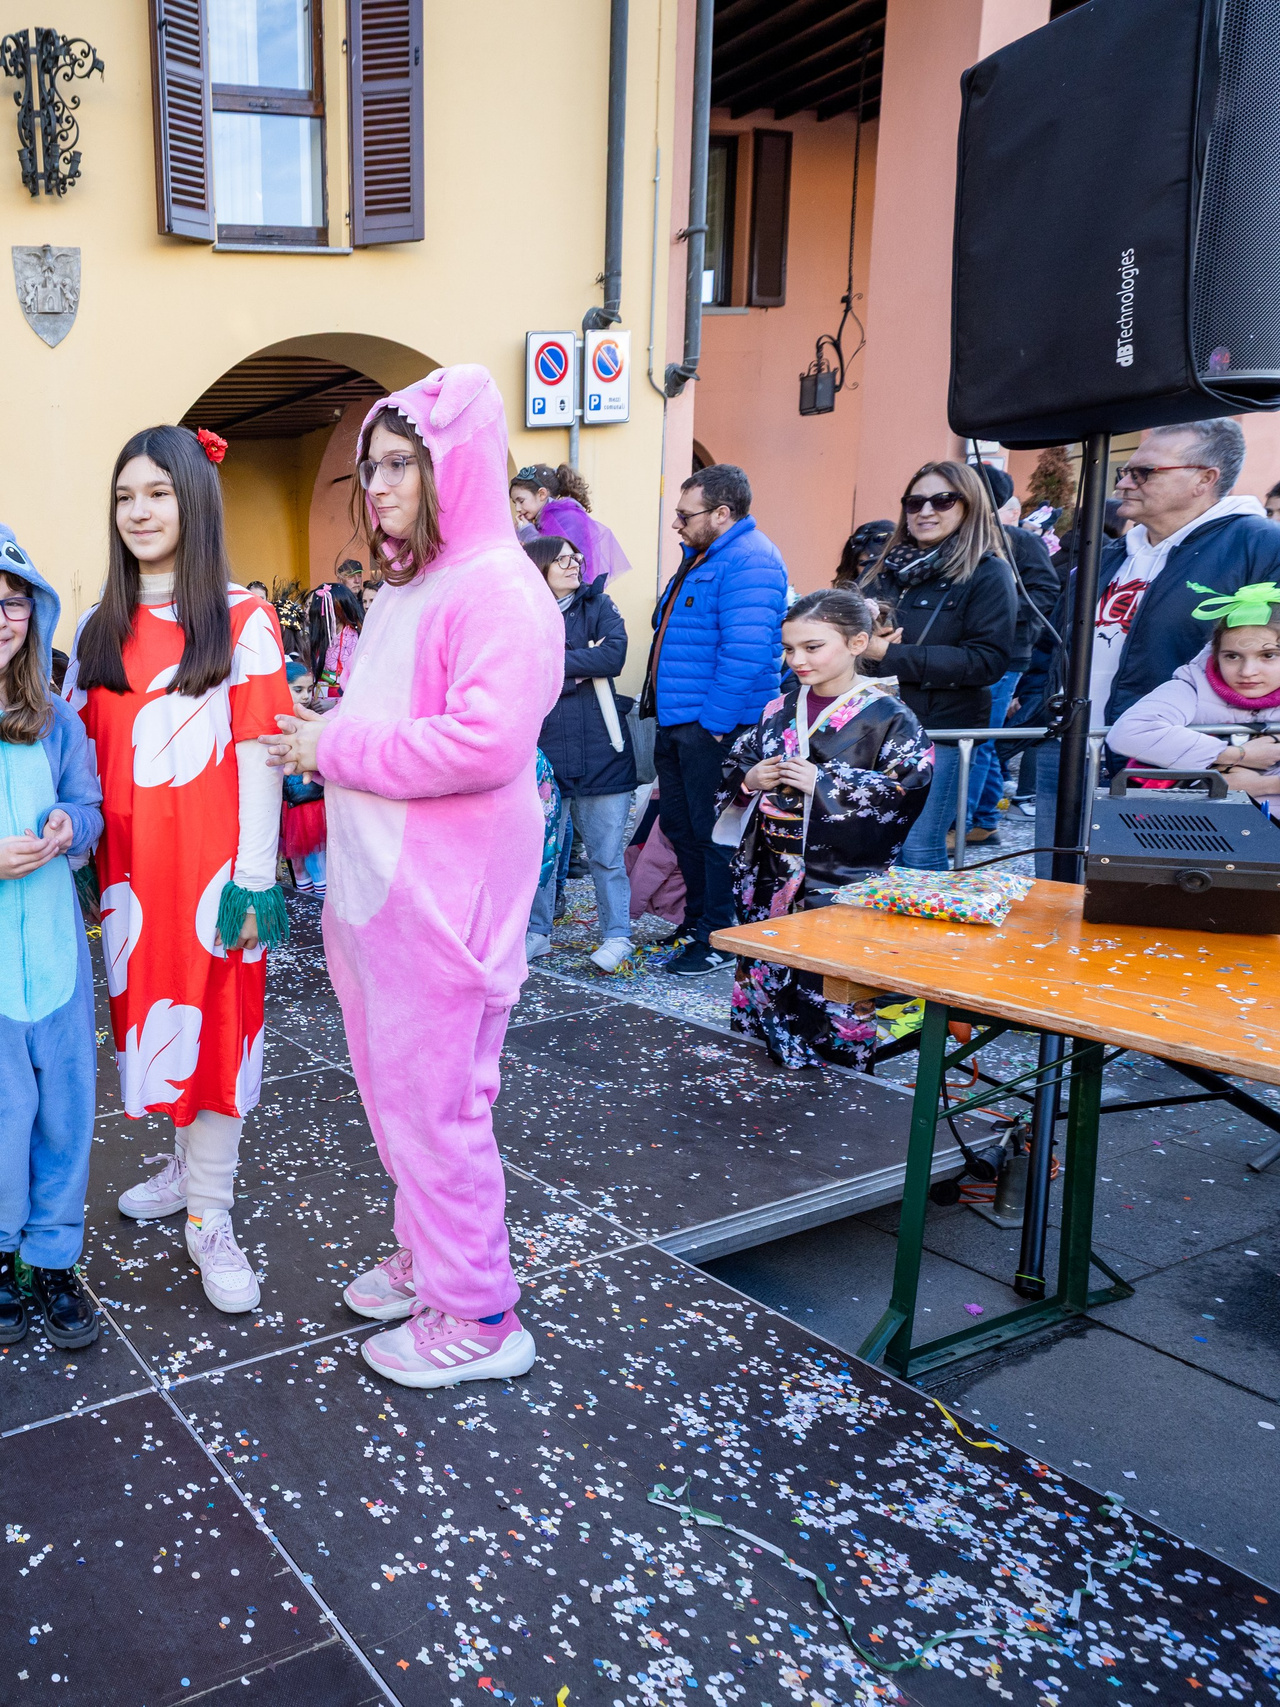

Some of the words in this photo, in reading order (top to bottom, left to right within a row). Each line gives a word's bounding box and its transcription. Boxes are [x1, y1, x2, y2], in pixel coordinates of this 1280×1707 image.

[1116, 248, 1139, 367] dBTechnologies
[534, 399, 544, 414] P
[589, 395, 600, 410] P
